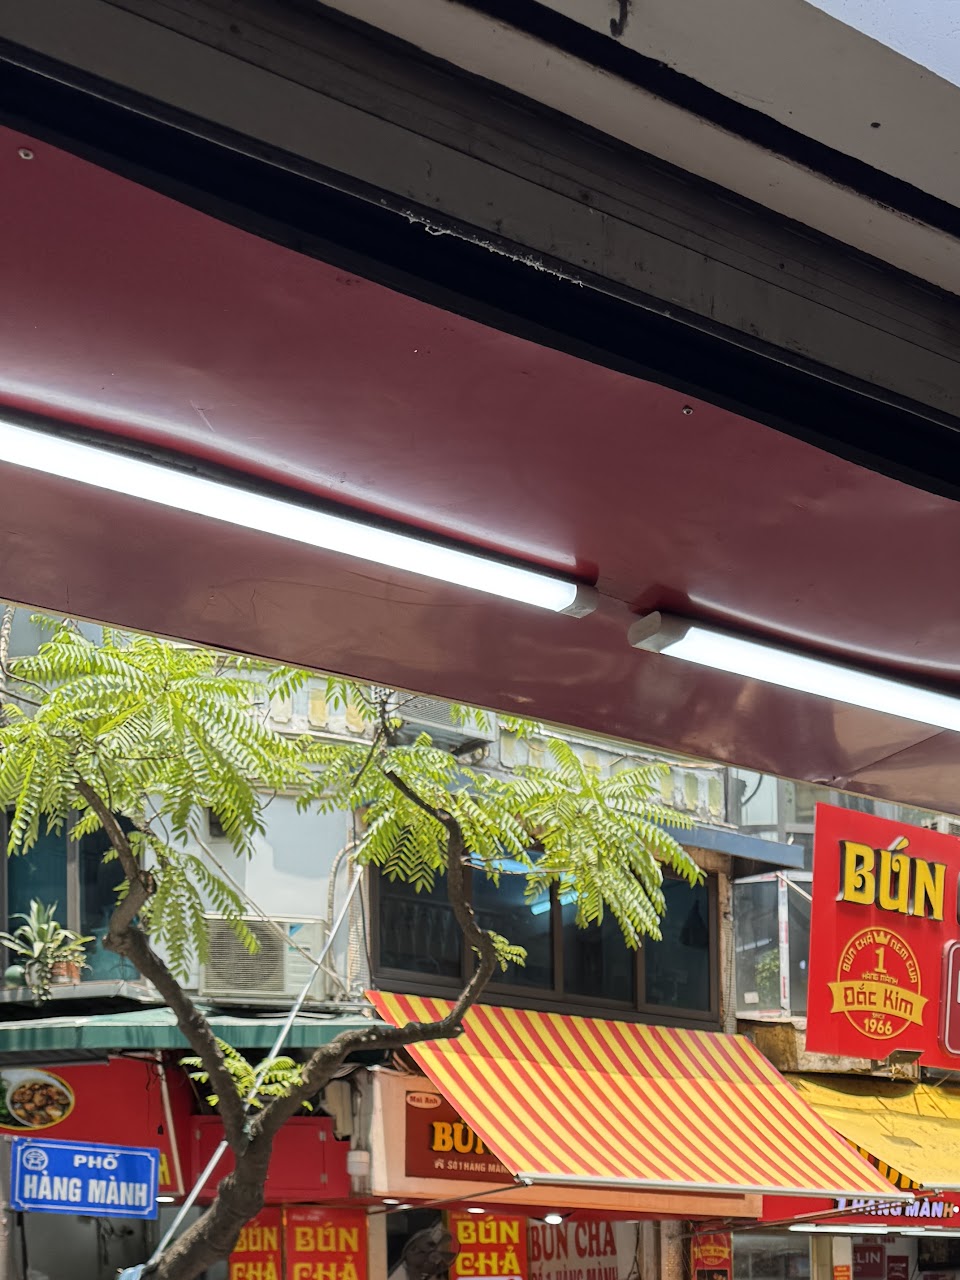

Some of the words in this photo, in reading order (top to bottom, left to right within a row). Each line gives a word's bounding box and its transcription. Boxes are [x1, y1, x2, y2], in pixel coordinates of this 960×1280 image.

[838, 836, 947, 921] BÚN
[874, 947, 887, 974] 1
[864, 1018, 893, 1035] 1966
[73, 1153, 120, 1170] PHỐ
[24, 1170, 82, 1202] HÀNG
[87, 1175, 148, 1206] MÀNH
[904, 1197, 955, 1218] MÀNH
[294, 1222, 359, 1252] BÚN
[457, 1215, 520, 1245] BÚN
[456, 1245, 521, 1276] CHẢ
